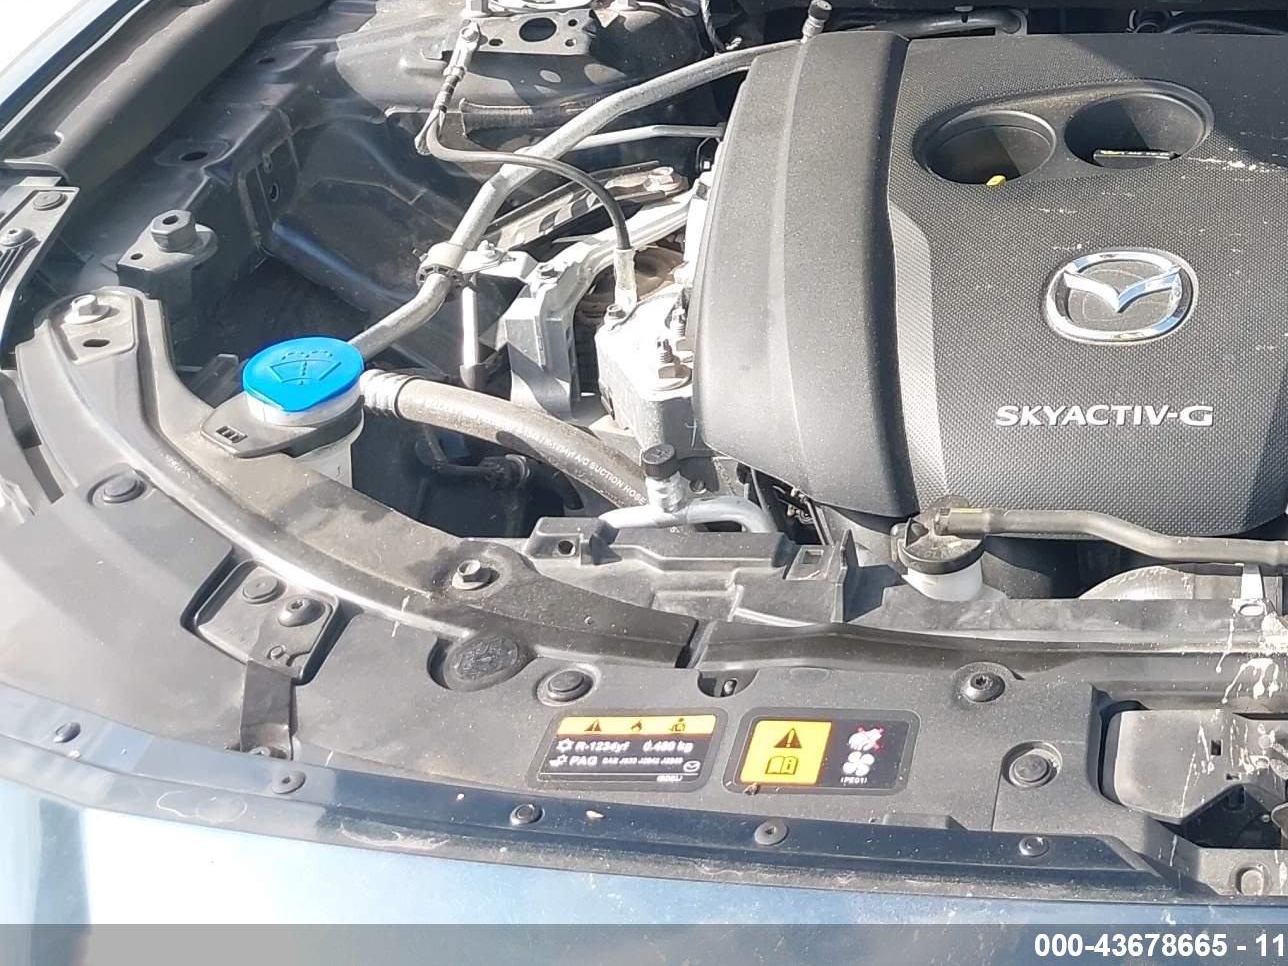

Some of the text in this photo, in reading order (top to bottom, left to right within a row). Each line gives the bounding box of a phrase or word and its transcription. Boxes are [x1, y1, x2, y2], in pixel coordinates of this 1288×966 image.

[995, 404, 1213, 426] SKYACTIV-G
[590, 462, 624, 488] SUCTION
[623, 484, 648, 506] HOSE
[574, 740, 630, 753] R-1234yf
[569, 755, 598, 766] PAG
